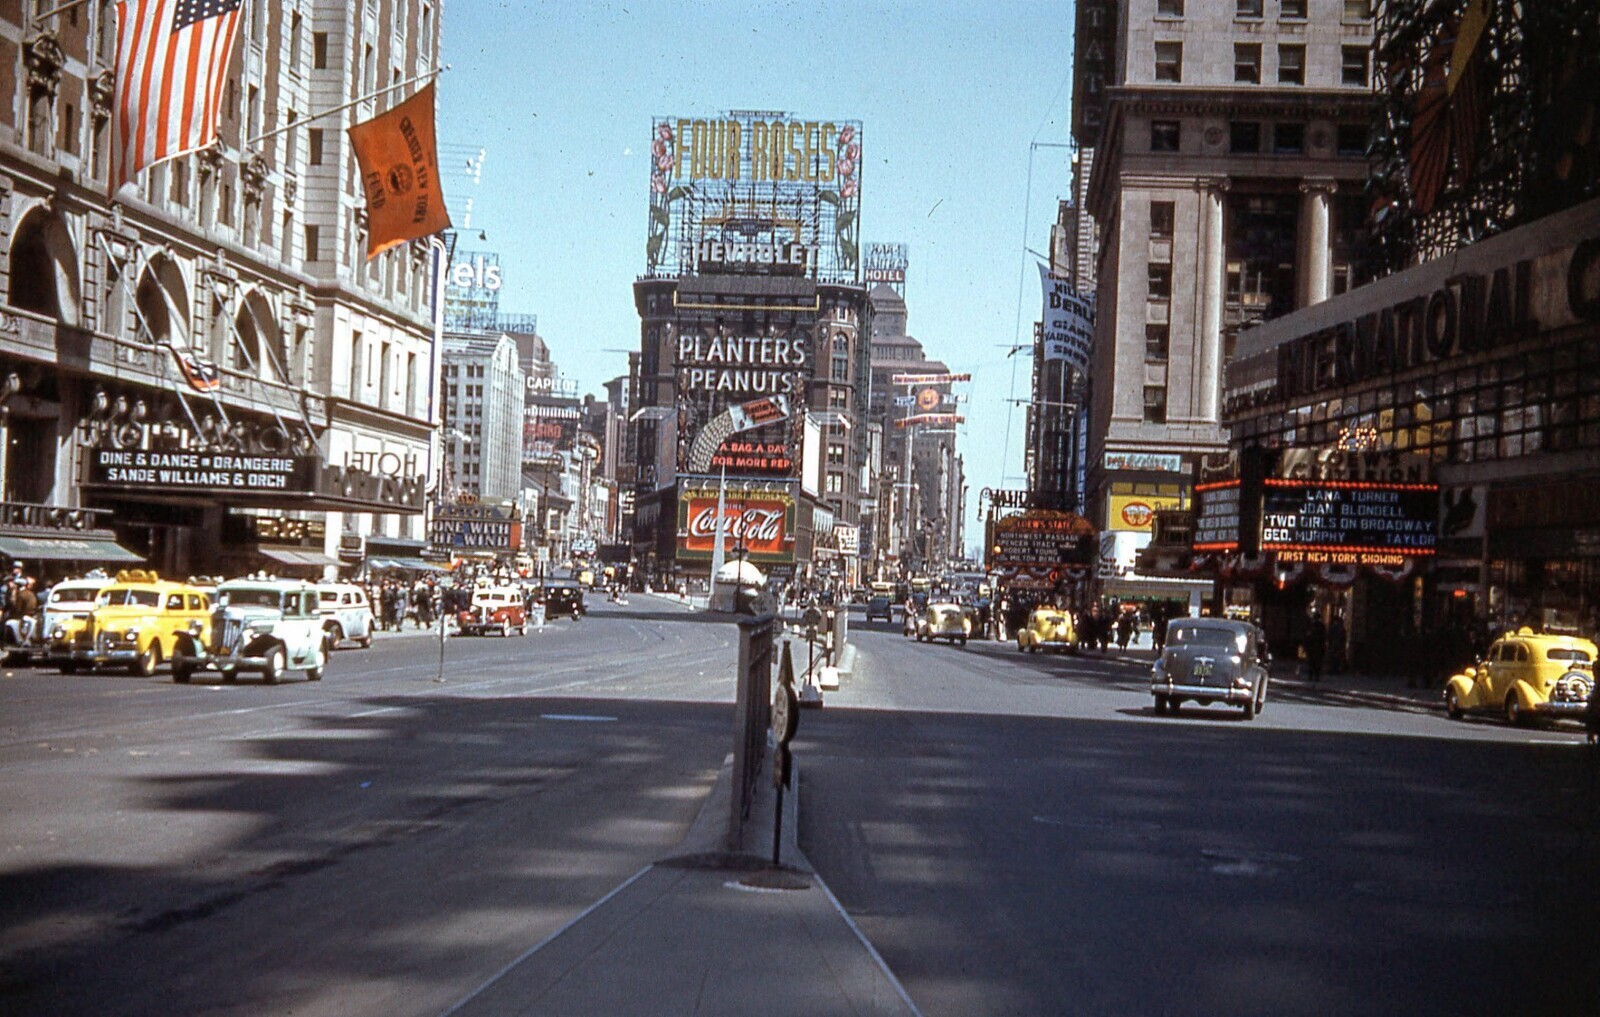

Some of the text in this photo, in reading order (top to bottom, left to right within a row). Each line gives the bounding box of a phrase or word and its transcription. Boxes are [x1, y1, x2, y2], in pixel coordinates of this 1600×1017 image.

[674, 118, 837, 182] FOUR ROSES
[417, 165, 429, 189] NEW
[366, 171, 386, 210] FUND
[412, 193, 429, 224] YORK
[677, 240, 820, 265] CHEVROLET
[445, 255, 501, 290] els
[864, 269, 904, 282] HOTEL
[678, 335, 806, 364] PLANTERS
[690, 367, 793, 393] PEANUTS
[719, 442, 788, 454] A BAG A DAY
[99, 451, 294, 472] DINE & DANCE ORANGERIE
[712, 456, 790, 469] FOR MORE PEP
[107, 468, 286, 488] SANDE WILLIAMS & ORCH
[1306, 490, 1342, 501] LANA
[1350, 490, 1399, 503] TURNER
[1299, 503, 1405, 517] JOAN BLONDELL
[470, 522, 509, 534] WITH
[1300, 516, 1337, 529] GIRLS
[1340, 518, 1358, 530] ON
[464, 534, 508, 546] WIND
[1263, 528, 1292, 542] GEO.
[1295, 530, 1346, 543] MURPHY
[1386, 533, 1436, 545] TAYLOR
[1277, 551, 1404, 565] FIRST NEW YORK SHOWING
